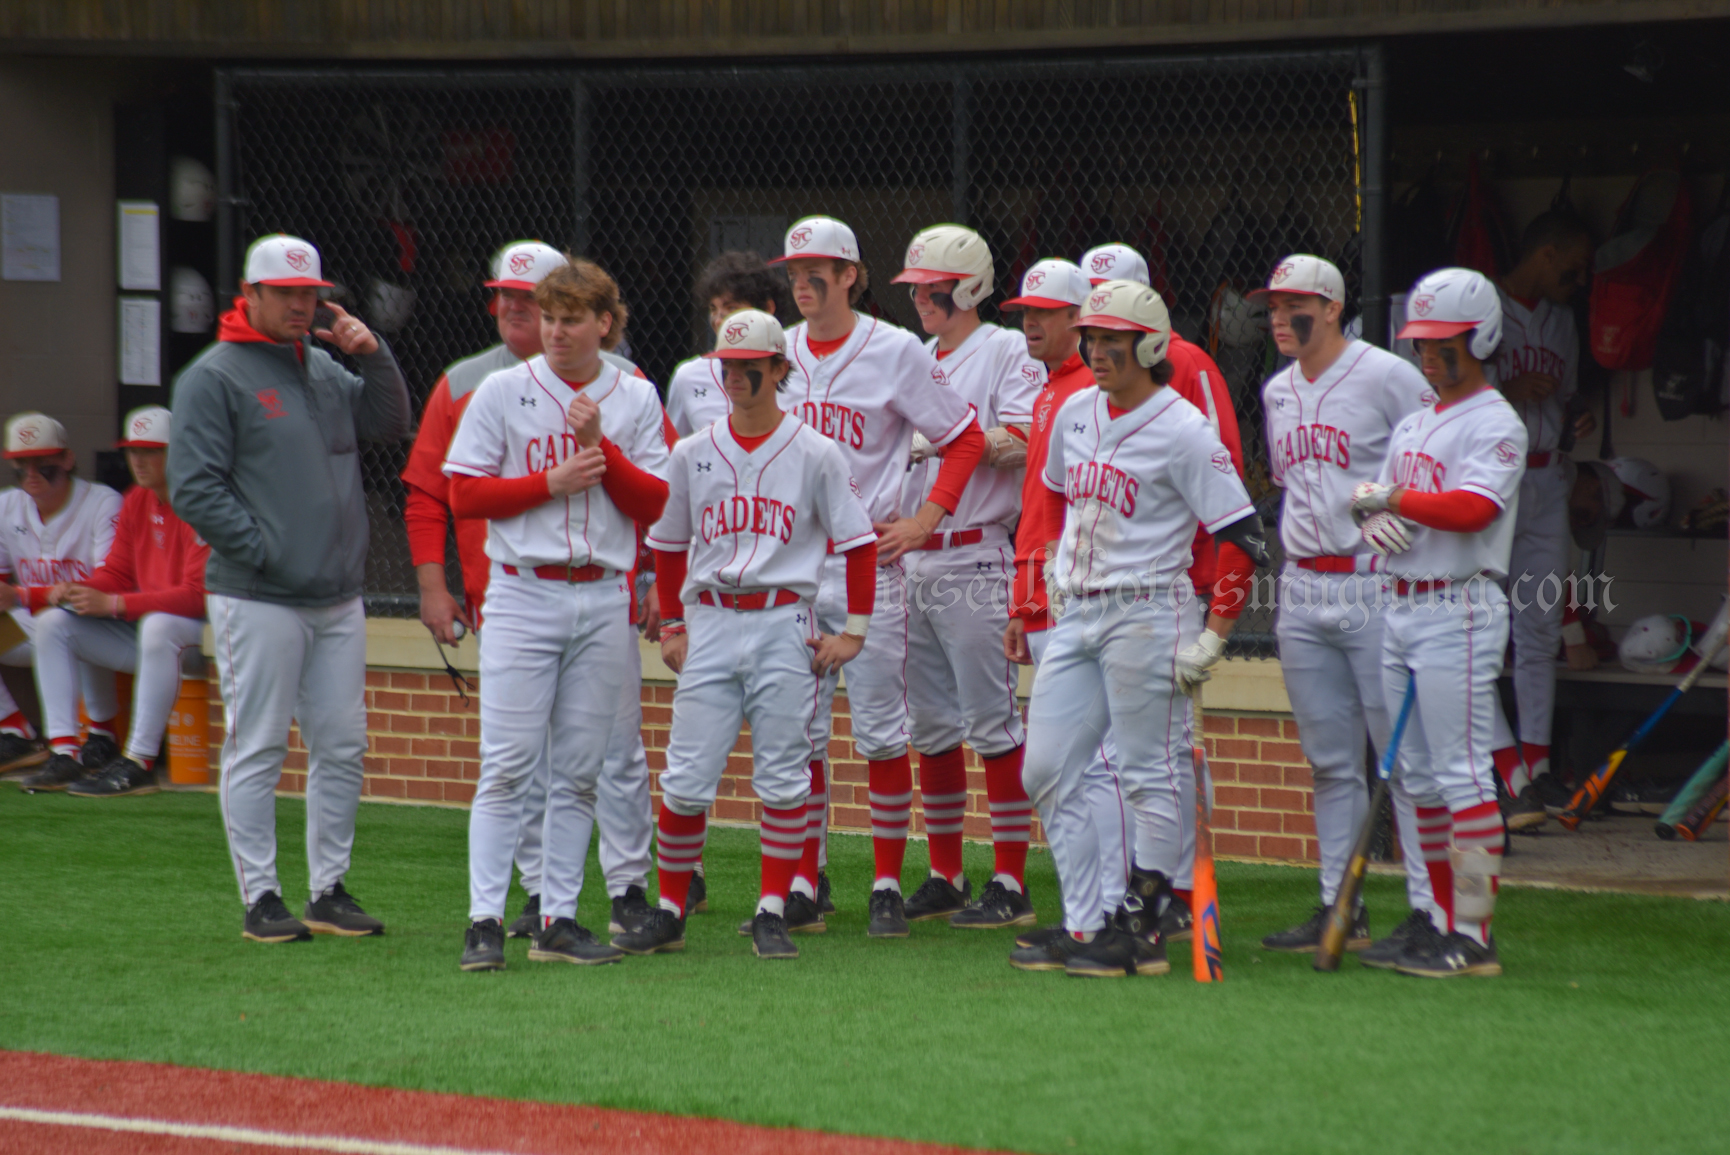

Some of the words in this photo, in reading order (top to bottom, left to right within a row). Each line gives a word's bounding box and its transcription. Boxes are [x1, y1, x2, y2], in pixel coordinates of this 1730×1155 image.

[1277, 423, 1350, 475] CADETS
[1066, 461, 1139, 518] CADETS
[701, 496, 796, 545] CADETS
